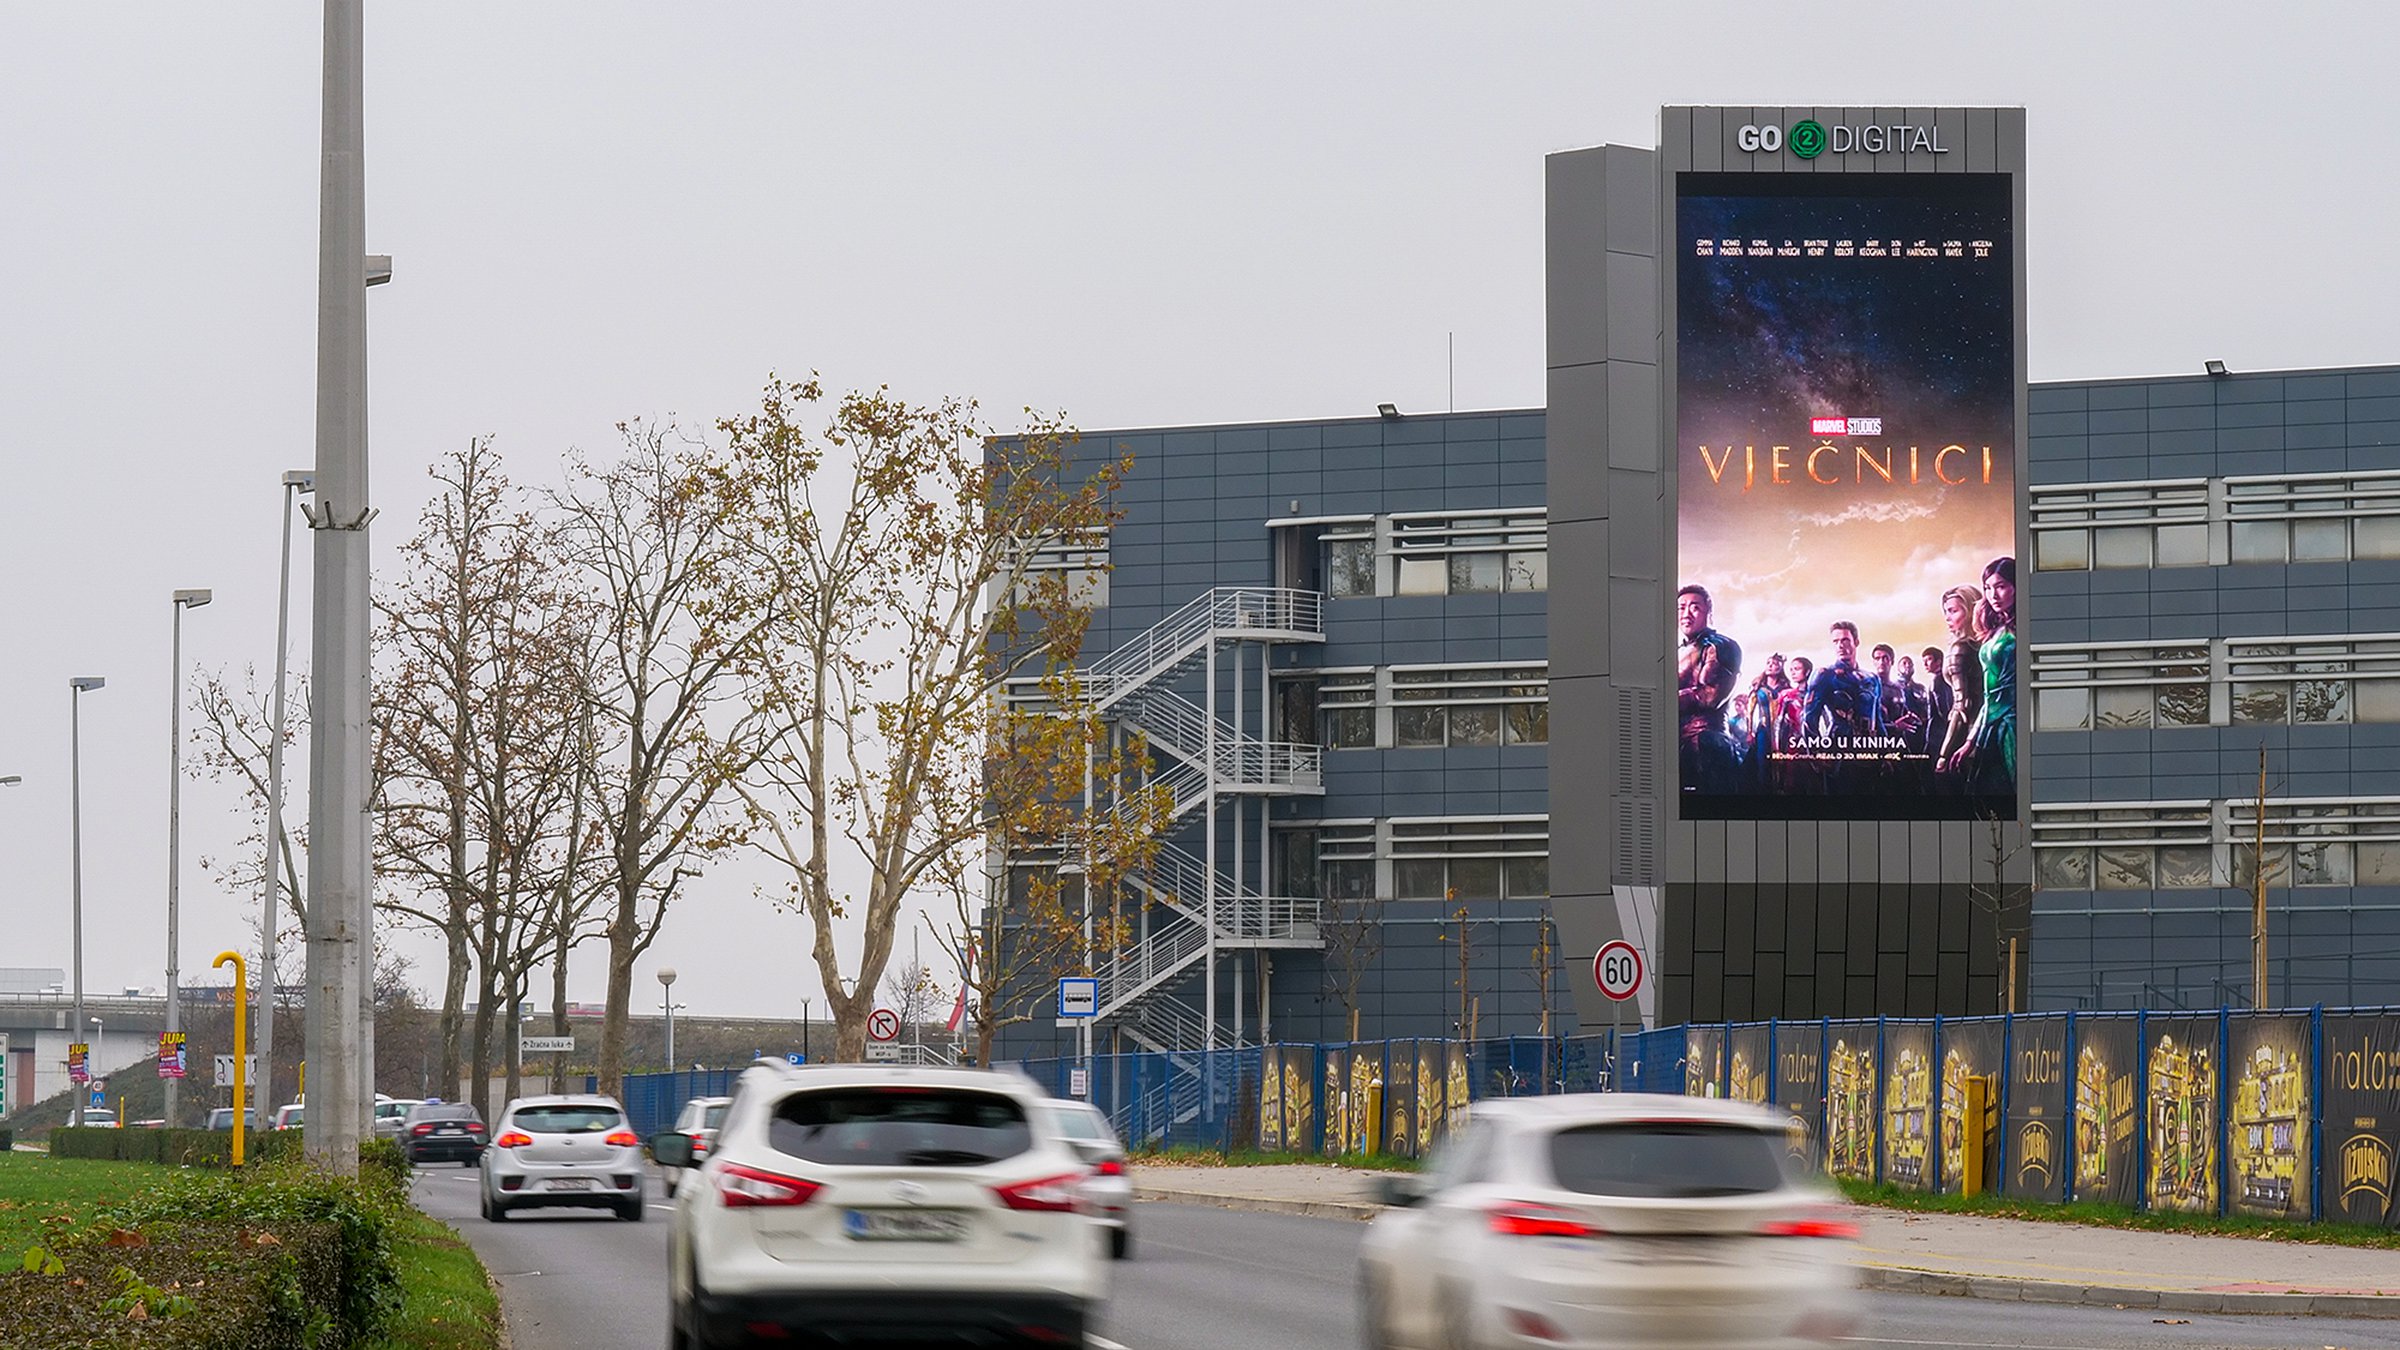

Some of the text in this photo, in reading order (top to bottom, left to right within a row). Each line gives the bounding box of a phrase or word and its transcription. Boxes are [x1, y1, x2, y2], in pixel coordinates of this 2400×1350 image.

[1738, 124, 1948, 153] GO 2 DIGITAL
[1812, 418, 1882, 435] MARVEL STUDIOS
[1699, 440, 1992, 496] VJEČNICI
[1789, 736, 1907, 749] SAMO U KINIMA
[1606, 957, 1631, 985] 60
